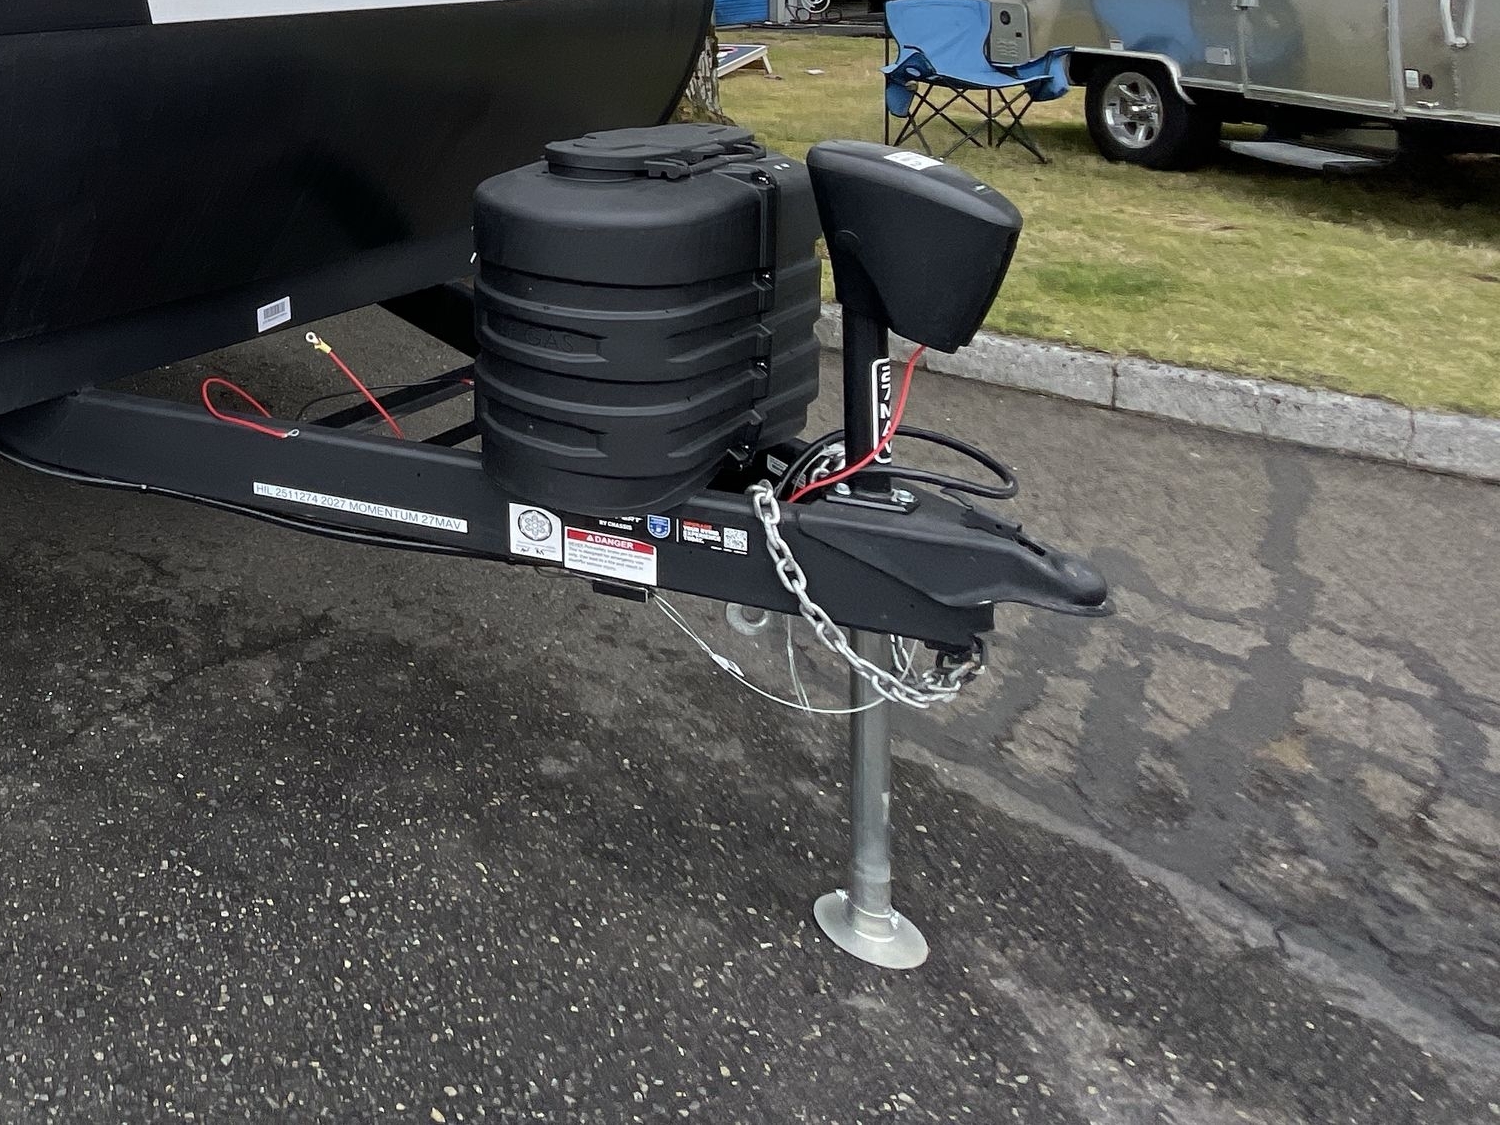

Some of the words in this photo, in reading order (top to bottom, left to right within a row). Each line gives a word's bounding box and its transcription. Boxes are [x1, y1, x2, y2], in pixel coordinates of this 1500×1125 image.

[256, 484, 274, 496] HIL
[275, 486, 318, 504] 2511274
[320, 495, 346, 509] 2027
[349, 500, 419, 523] MOMENTUM
[420, 514, 462, 530] 27MAV
[594, 535, 635, 550] DANGER
